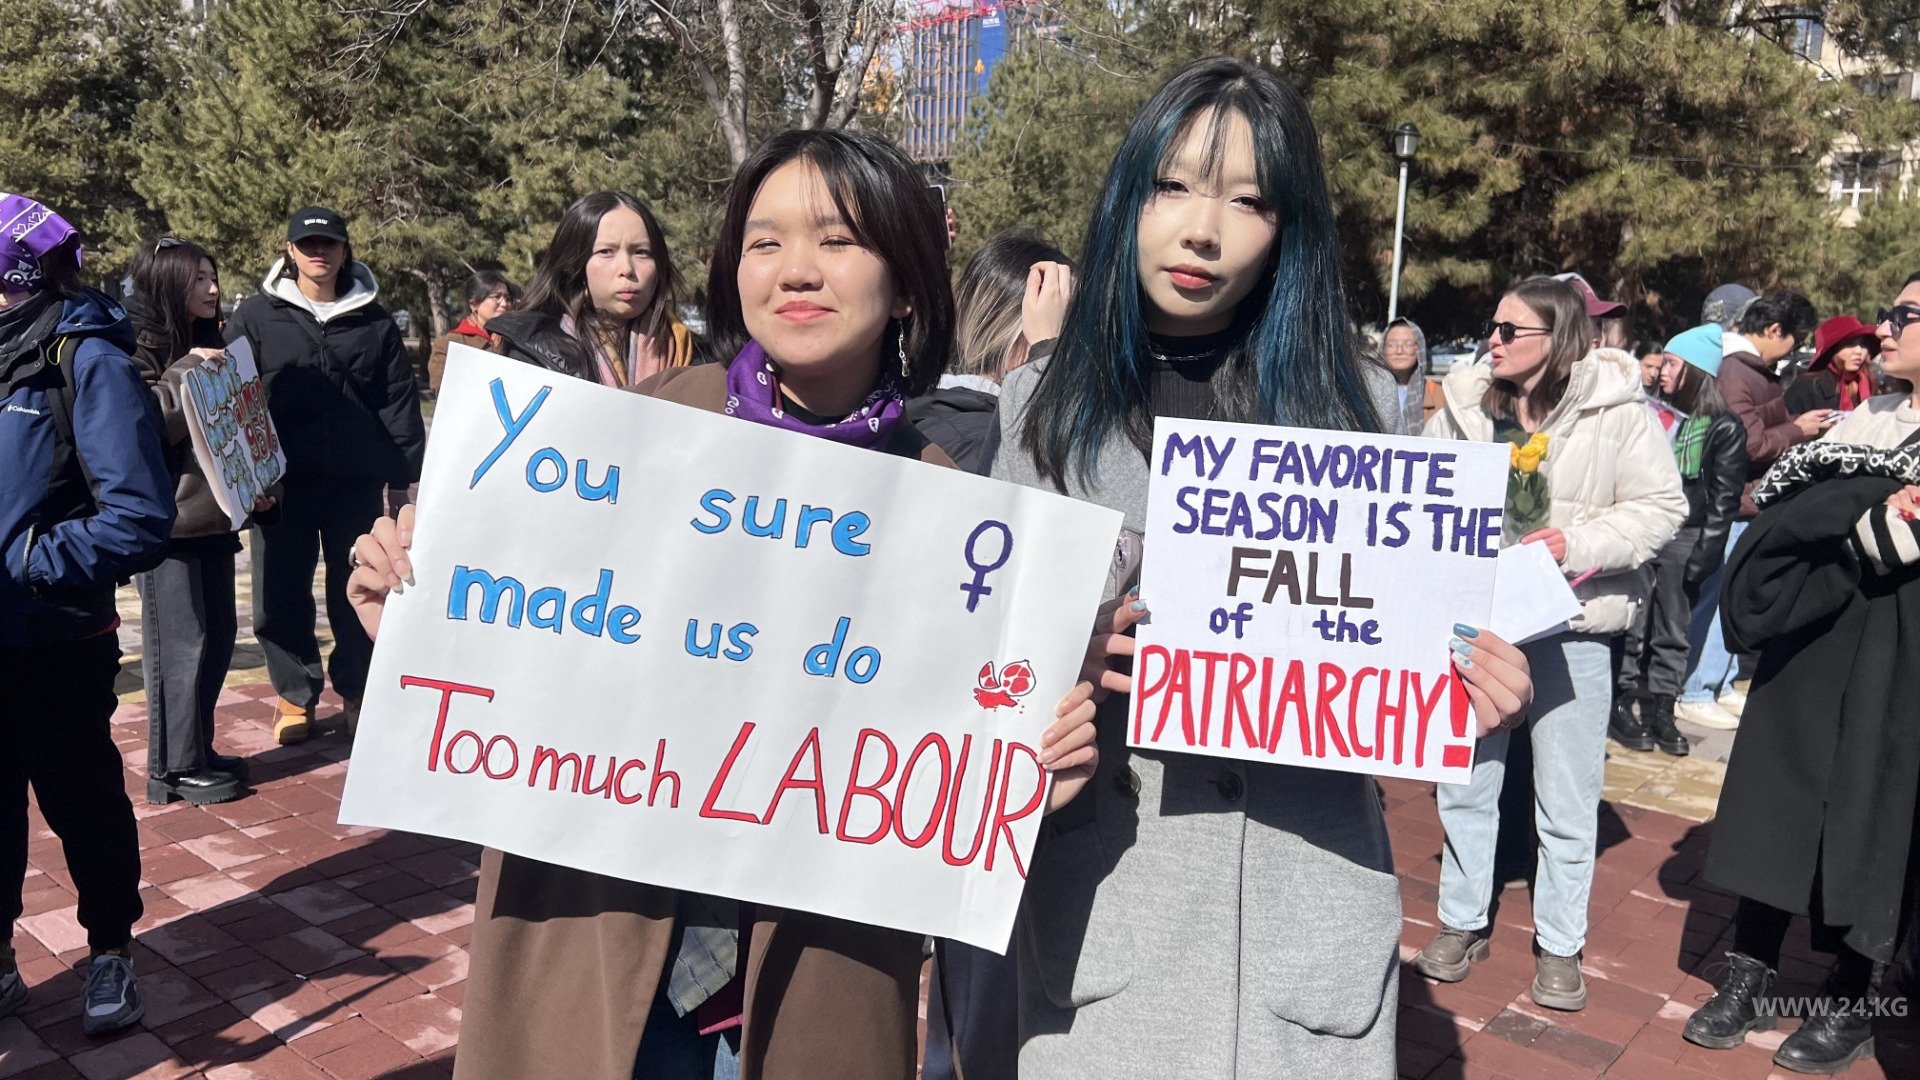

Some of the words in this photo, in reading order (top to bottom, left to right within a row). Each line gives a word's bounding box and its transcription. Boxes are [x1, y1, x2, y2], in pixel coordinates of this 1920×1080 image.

[469, 377, 620, 504] You
[690, 488, 871, 556] sure
[1161, 432, 1236, 481] MY
[1249, 438, 1457, 497] FAVORITE
[1172, 486, 1338, 544] SEASON
[1366, 501, 1412, 548] IS
[1423, 503, 1503, 558] THE
[447, 565, 641, 644] made
[684, 618, 759, 661] us
[803, 616, 881, 684] do
[1209, 602, 1253, 639] of
[1312, 609, 1382, 645] the
[1226, 546, 1374, 609] FALL
[1133, 644, 1472, 768] PATRIARCHY!
[400, 675, 518, 780] Too
[528, 738, 681, 808] much
[698, 721, 1047, 879] LABOUR
